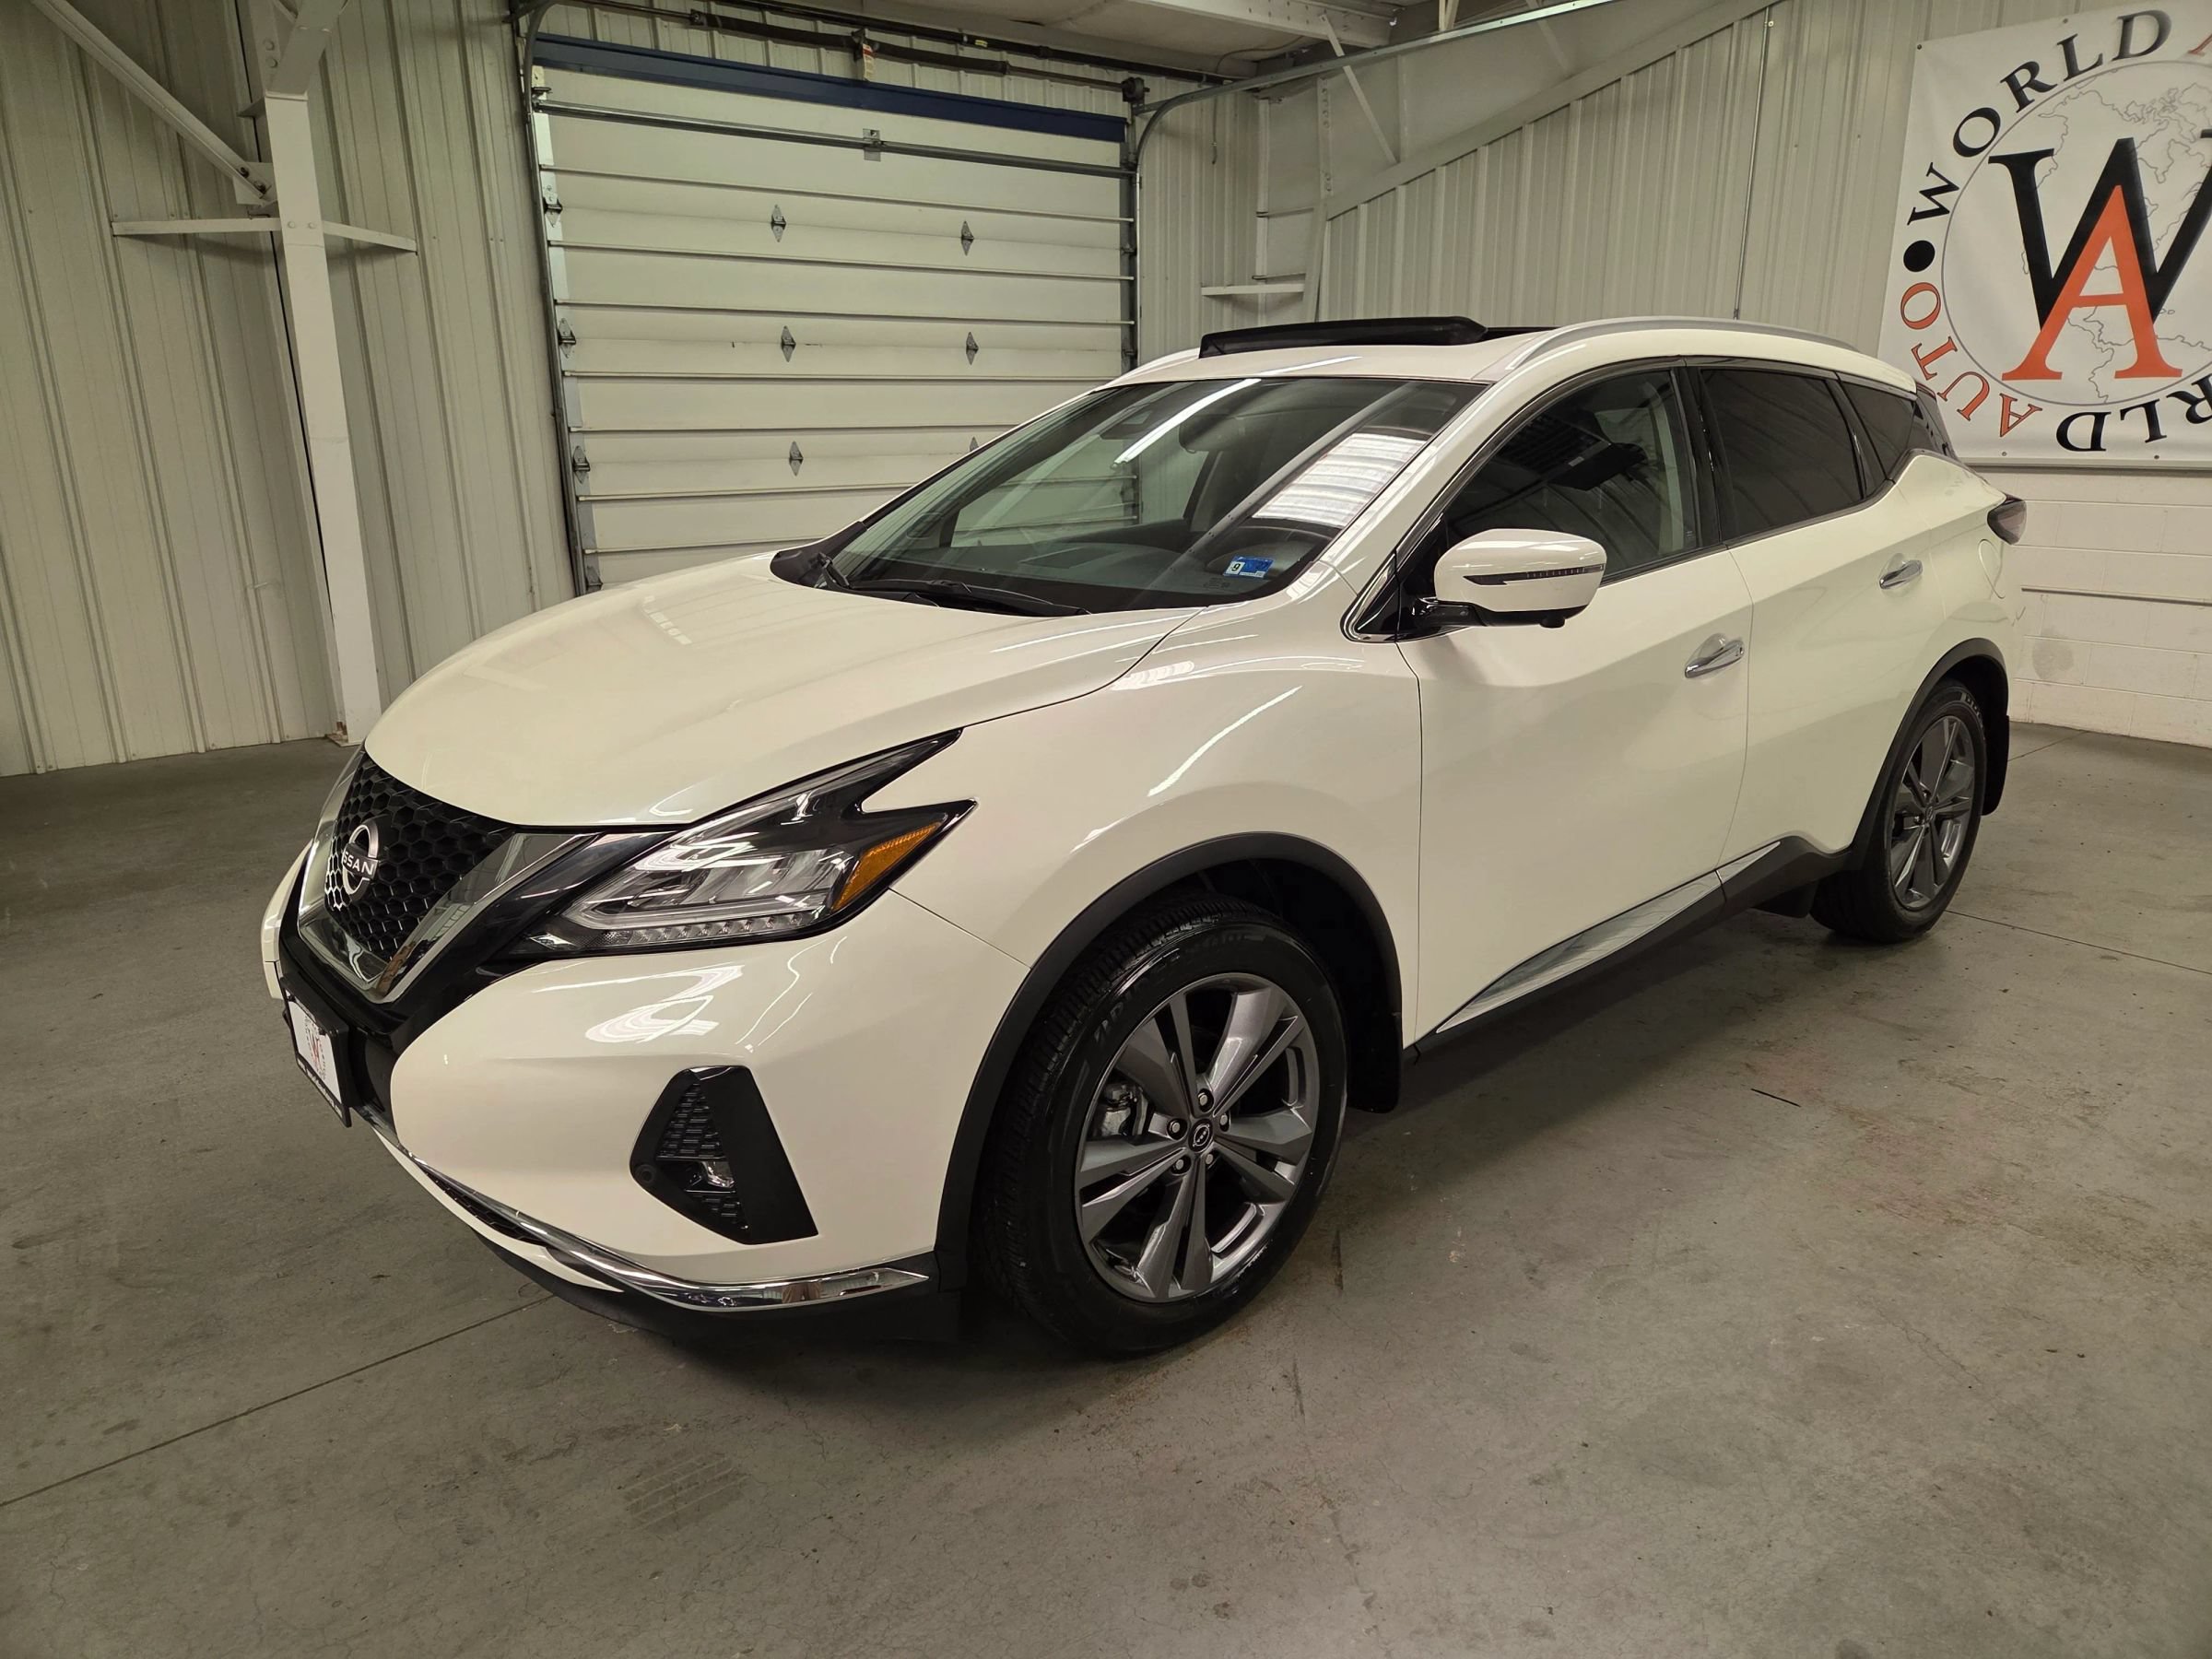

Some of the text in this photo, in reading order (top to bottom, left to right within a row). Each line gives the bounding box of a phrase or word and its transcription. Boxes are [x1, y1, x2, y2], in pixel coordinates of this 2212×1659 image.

[1907, 9, 2172, 226] WORLD
[1900, 282, 2212, 452] RLD AUTO
[1231, 563, 1241, 571] 9
[343, 851, 374, 876] SSAN
